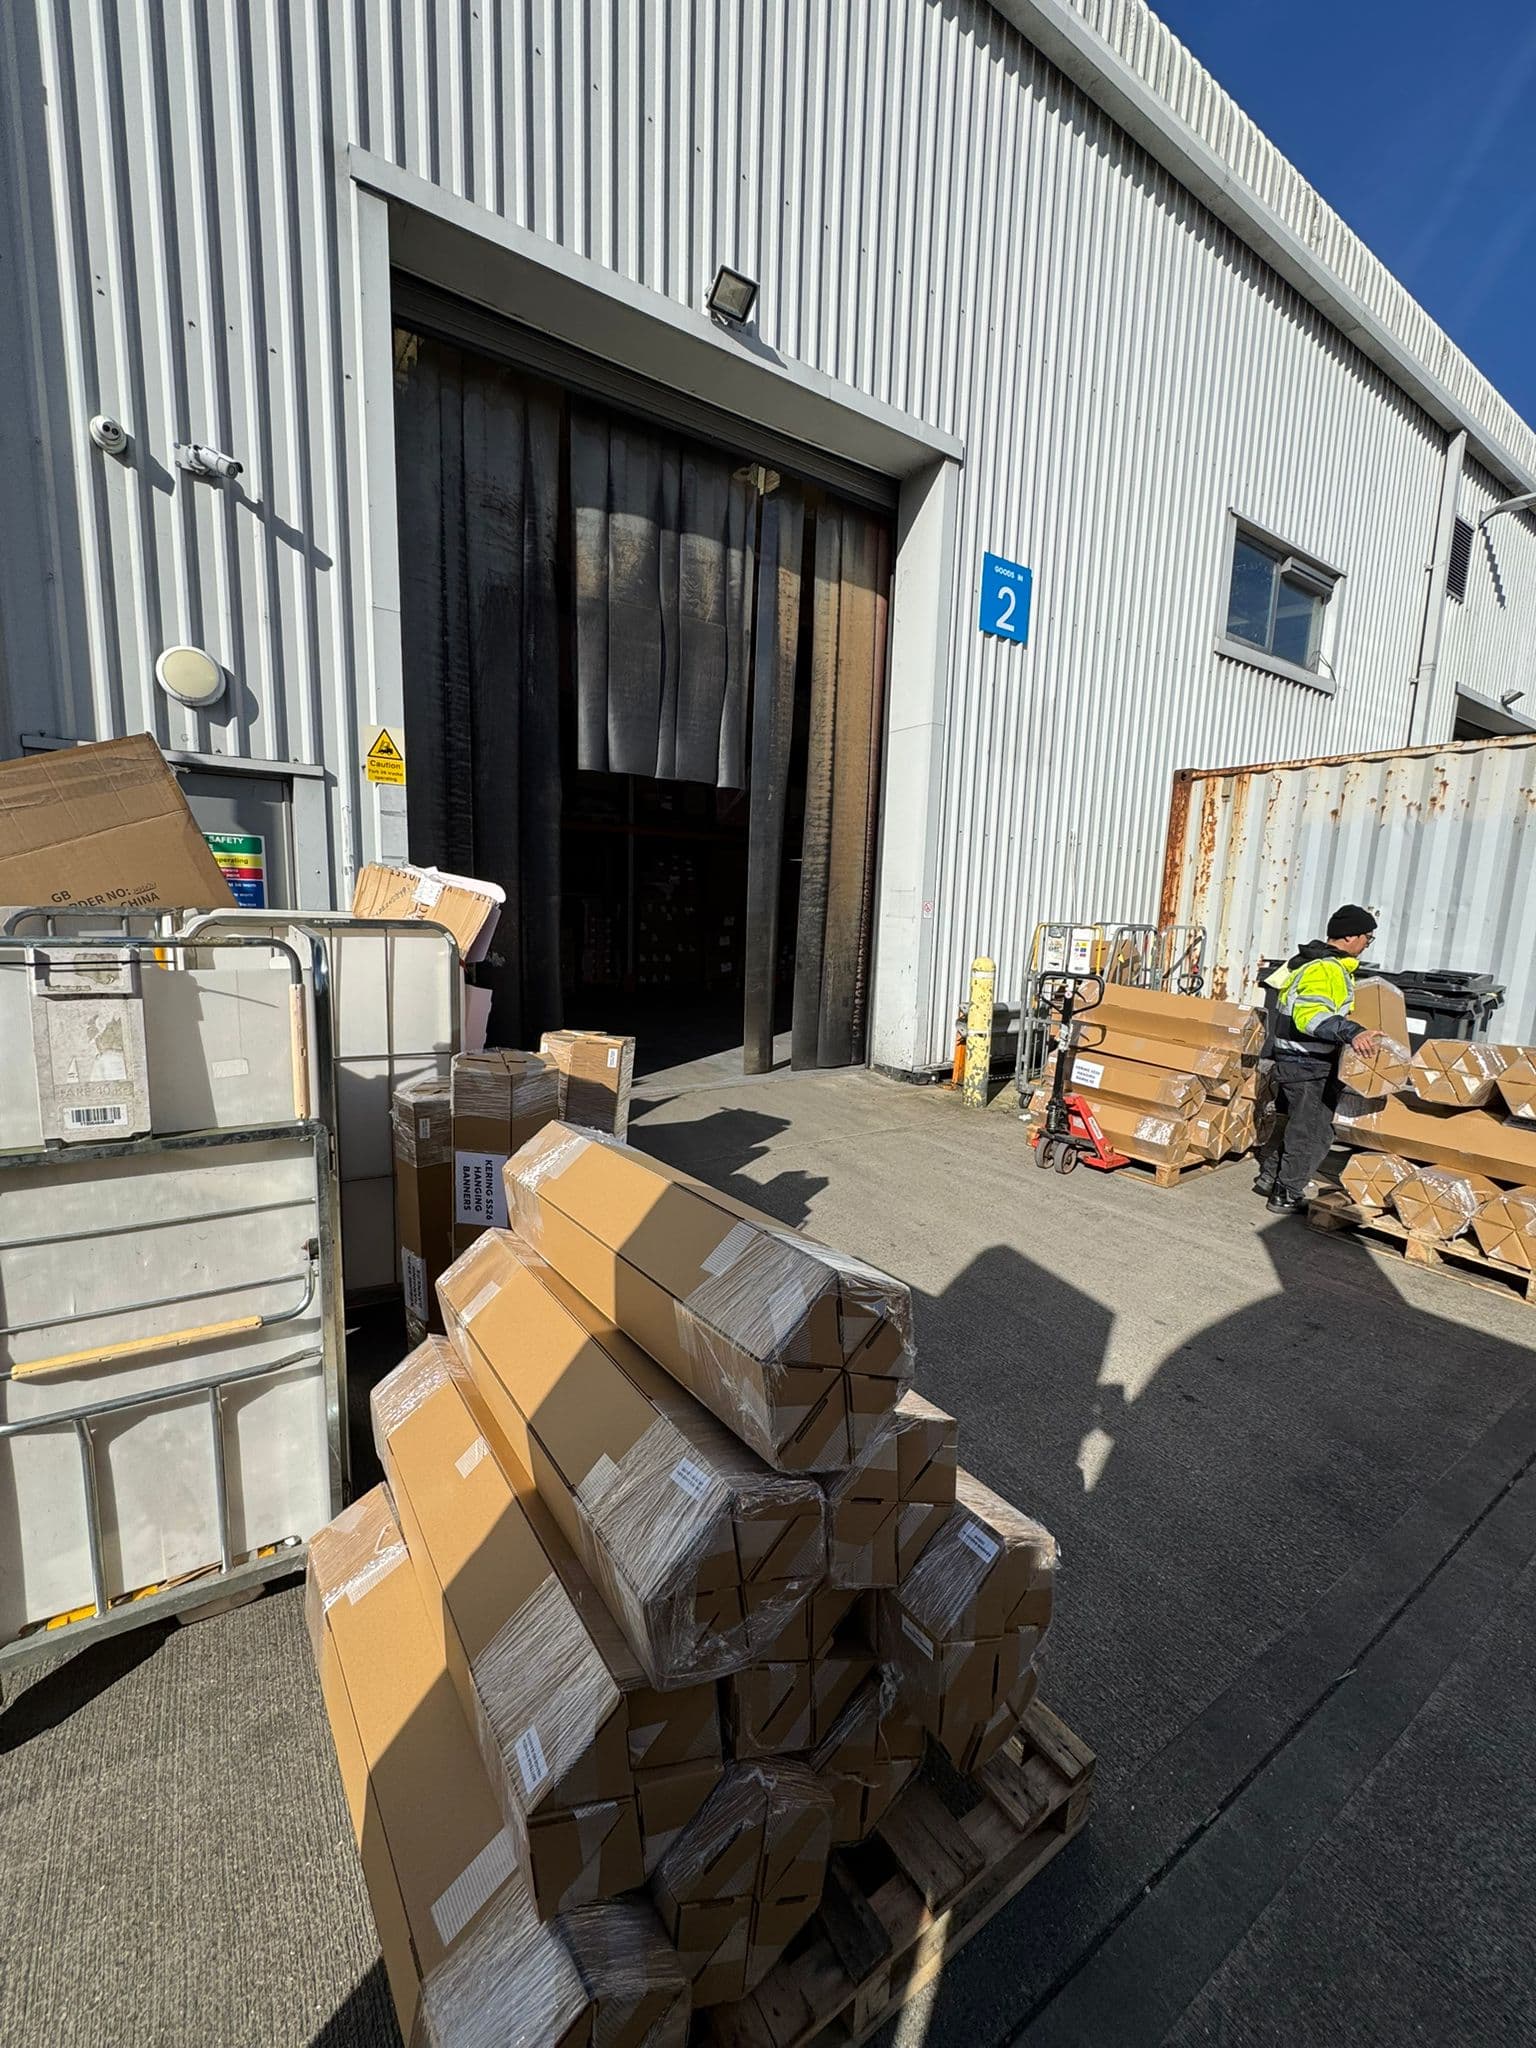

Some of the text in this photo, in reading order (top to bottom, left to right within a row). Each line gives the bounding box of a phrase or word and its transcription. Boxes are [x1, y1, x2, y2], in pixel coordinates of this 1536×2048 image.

[994, 565, 1015, 579] GOODS
[996, 585, 1016, 632] 2
[370, 760, 400, 769] Caution
[208, 835, 244, 844] SAFETY
[51, 890, 72, 903] GB
[106, 888, 131, 901] NO:
[463, 1165, 472, 1211] BANNERS
[474, 1166, 483, 1213] HANGING
[485, 1159, 493, 1221] KERING SS26
